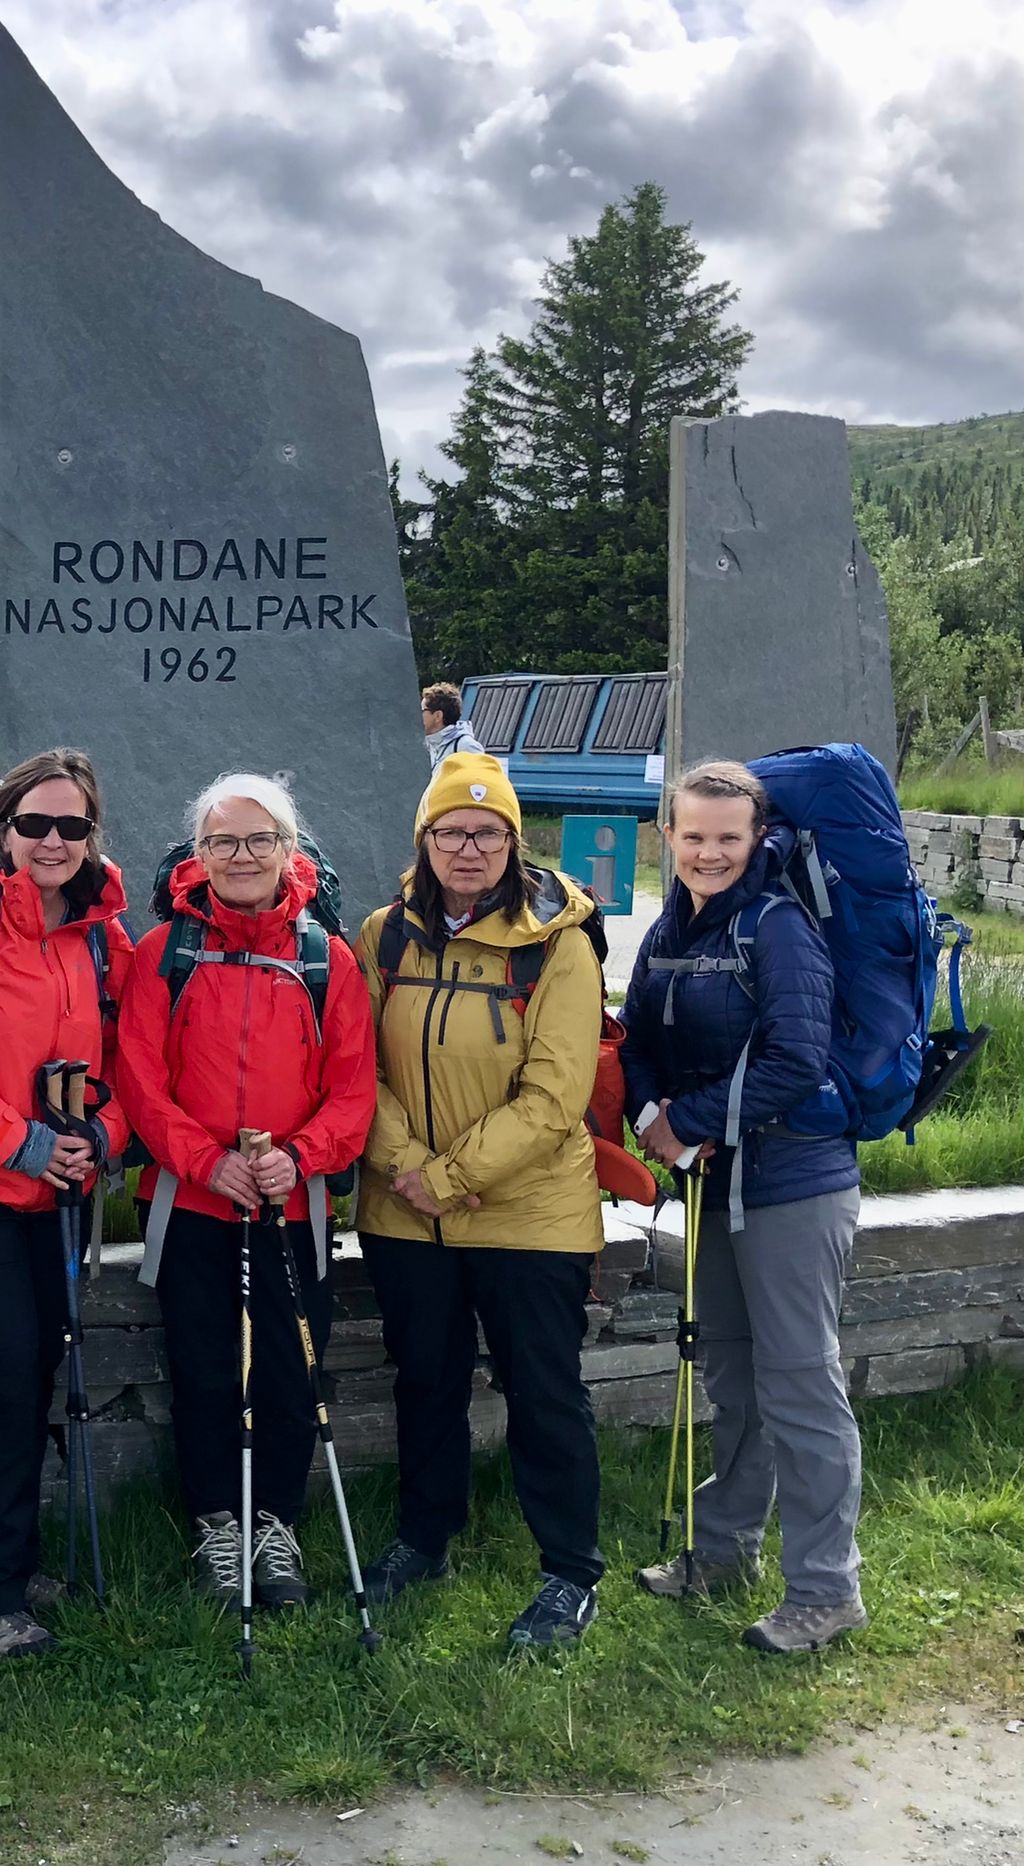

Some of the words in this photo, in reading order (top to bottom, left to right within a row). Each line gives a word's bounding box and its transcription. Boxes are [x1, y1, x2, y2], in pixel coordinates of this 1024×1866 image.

[52, 537, 328, 584] RONDANE
[5, 594, 379, 634] NASJONALPARK
[143, 647, 237, 682] 1962
